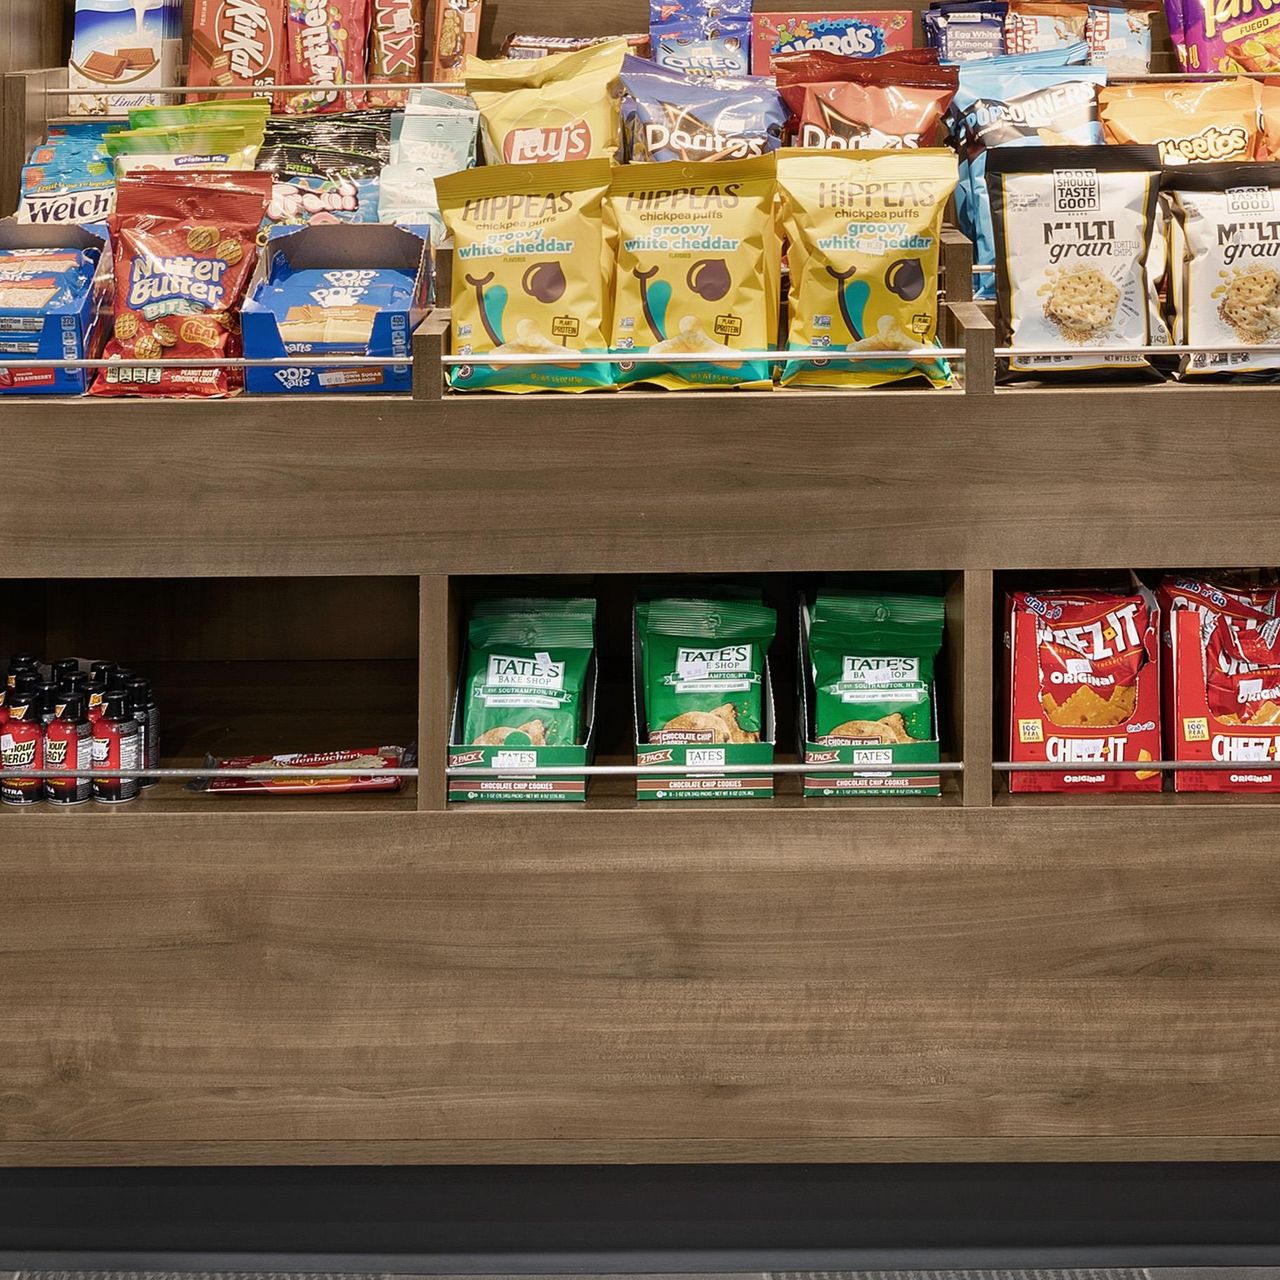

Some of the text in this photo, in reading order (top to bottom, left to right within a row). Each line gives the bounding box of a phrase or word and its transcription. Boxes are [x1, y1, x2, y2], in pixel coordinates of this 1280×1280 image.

[1240, 18, 1269, 35] FUEGO
[954, 31, 970, 39] Egg
[954, 40, 993, 48] Almonds
[110, 95, 147, 107] Lindt
[646, 124, 766, 158] Doritos
[1057, 179, 1096, 187] SHOULD
[625, 184, 741, 211] HIPPEAS
[818, 181, 936, 209] HIPPEAS
[1058, 187, 1096, 198] TASTE
[28, 192, 114, 223] Welch'
[462, 191, 574, 221] HIPPEAS
[1058, 198, 1096, 209] GOOD
[1231, 201, 1270, 211] GOOD
[639, 211, 723, 222] chickpea puffs
[835, 209, 919, 220] chickpea puffs
[476, 216, 557, 231] chickpea puffs
[848, 223, 906, 236] groovy
[488, 228, 543, 244] groovy
[652, 224, 709, 237] groovy
[459, 239, 573, 258] white cheddar
[625, 236, 739, 251] white cheddar
[1049, 241, 1113, 265] grain
[133, 256, 227, 282] Nutter
[130, 275, 224, 305] Butter
[144, 299, 207, 320] BITES
[185, 322, 217, 338] REAL
[554, 326, 577, 334] PROTEIN
[716, 325, 740, 334] PROTEIN
[13, 373, 52, 382] STRAWBERRY
[283, 379, 310, 389] tarts
[1025, 595, 1047, 615] Grab
[1211, 592, 1227, 606] Go
[682, 646, 747, 663] TATE'S
[493, 658, 559, 678] TATES
[847, 658, 914, 671] TATE'S
[526, 677, 551, 685] SHOP
[662, 732, 712, 741] CHOCOLATE CHIP
[452, 753, 477, 763] 2 PACK
[640, 753, 665, 764] 2 PACK
[688, 750, 723, 760] TATE'S
[814, 752, 832, 760] PACK
[856, 751, 890, 761] TATE'S
[528, 782, 553, 790] COOKIES
[669, 780, 742, 788] CHOCOLATE CHIP COOKIES
